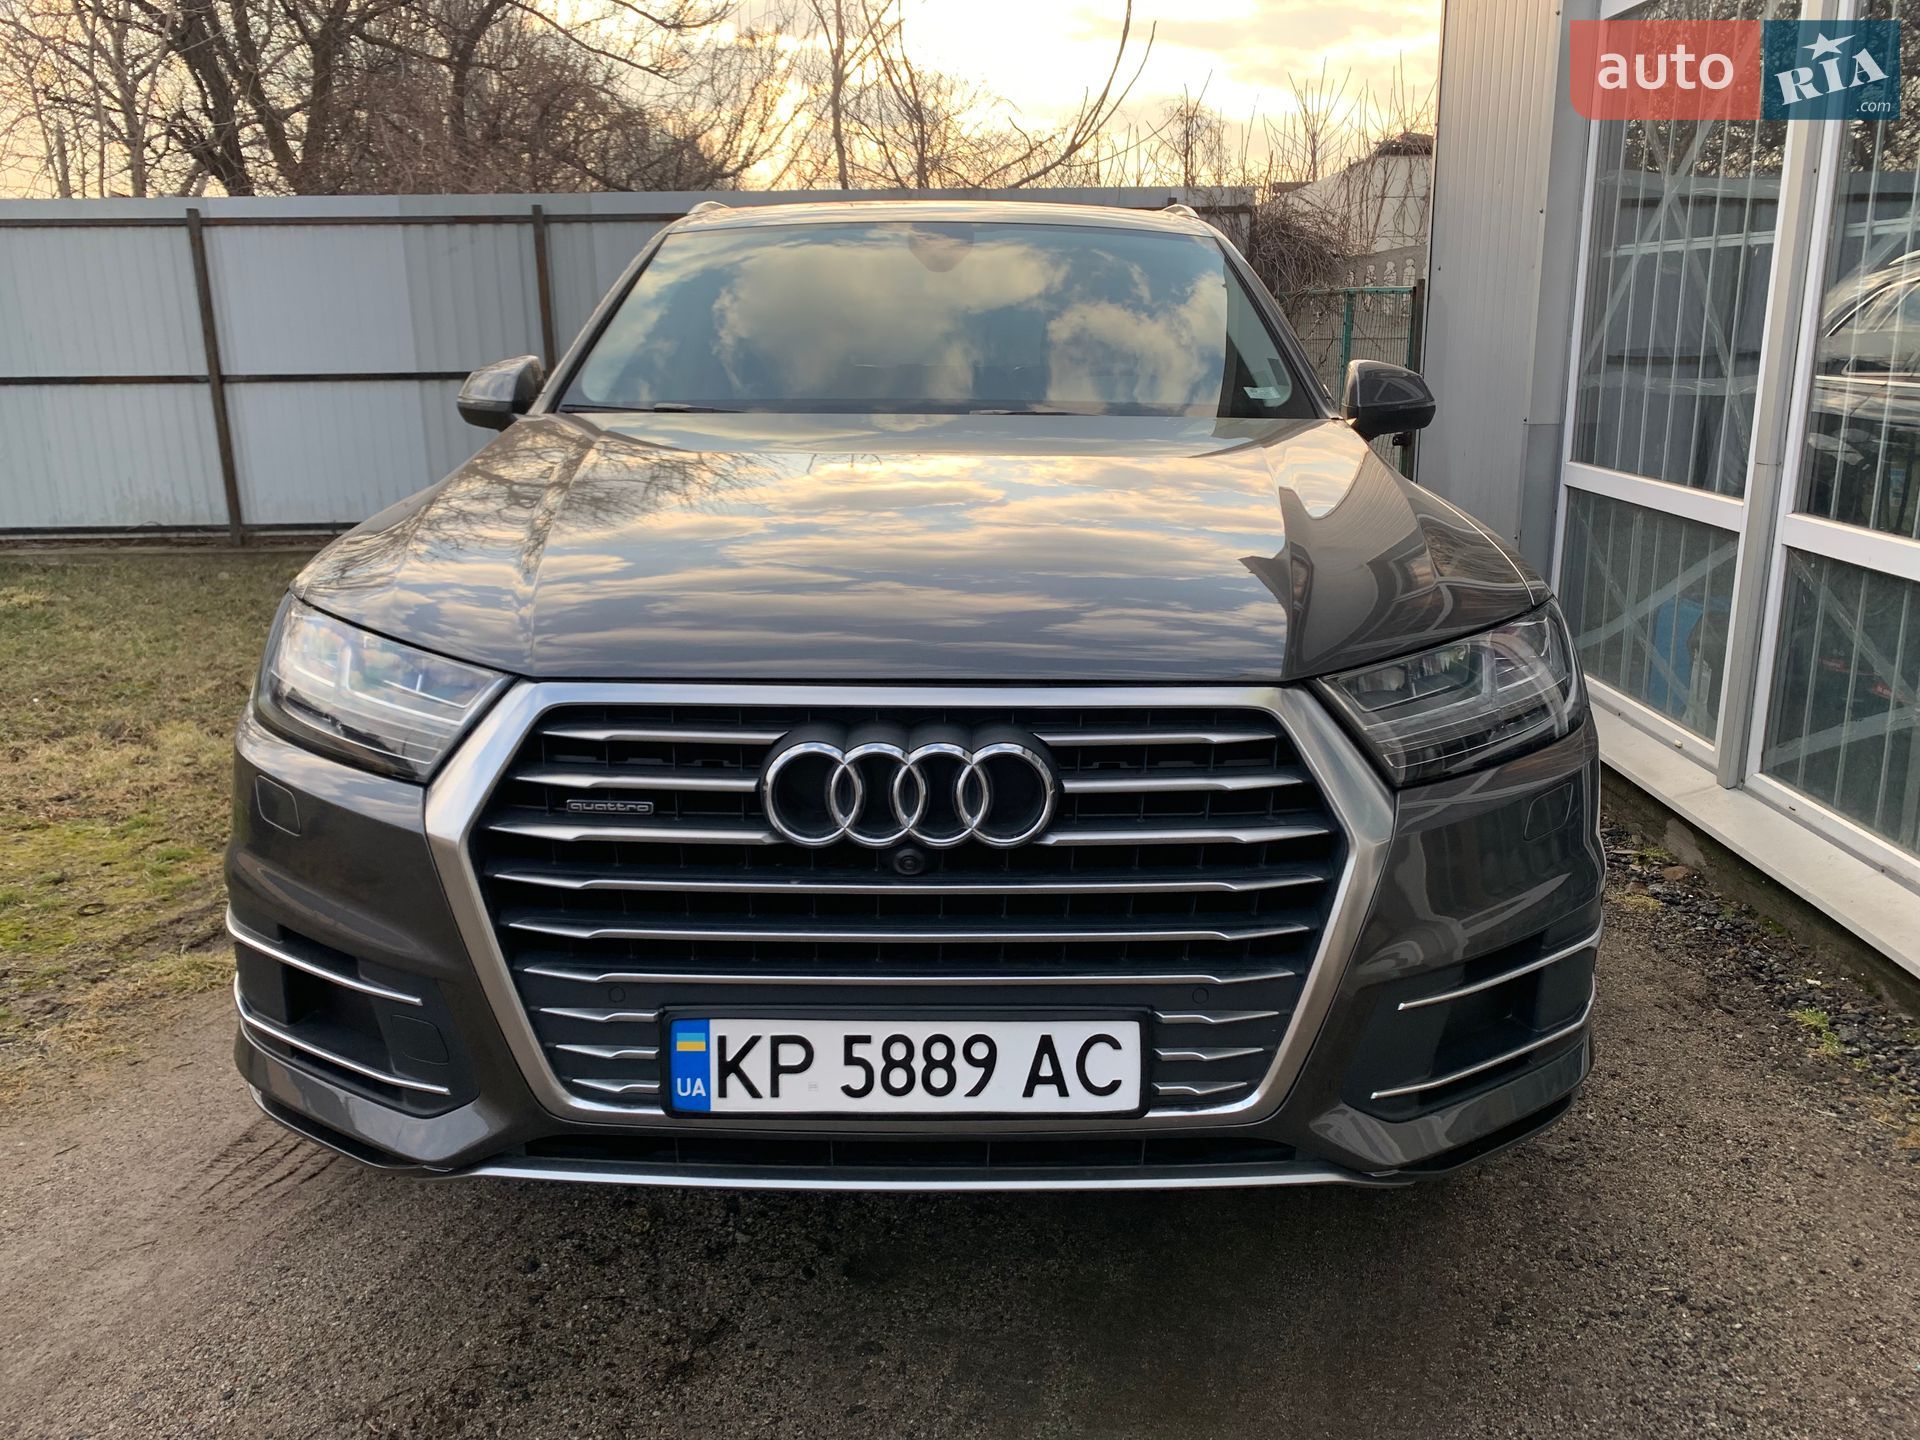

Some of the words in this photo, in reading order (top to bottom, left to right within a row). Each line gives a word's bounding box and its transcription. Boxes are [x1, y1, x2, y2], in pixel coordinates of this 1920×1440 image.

[570, 802, 649, 812] quattro
[717, 1034, 814, 1099] KP
[840, 1033, 997, 1098] 5889
[1022, 1033, 1122, 1098] AC
[677, 1077, 706, 1097] UA
